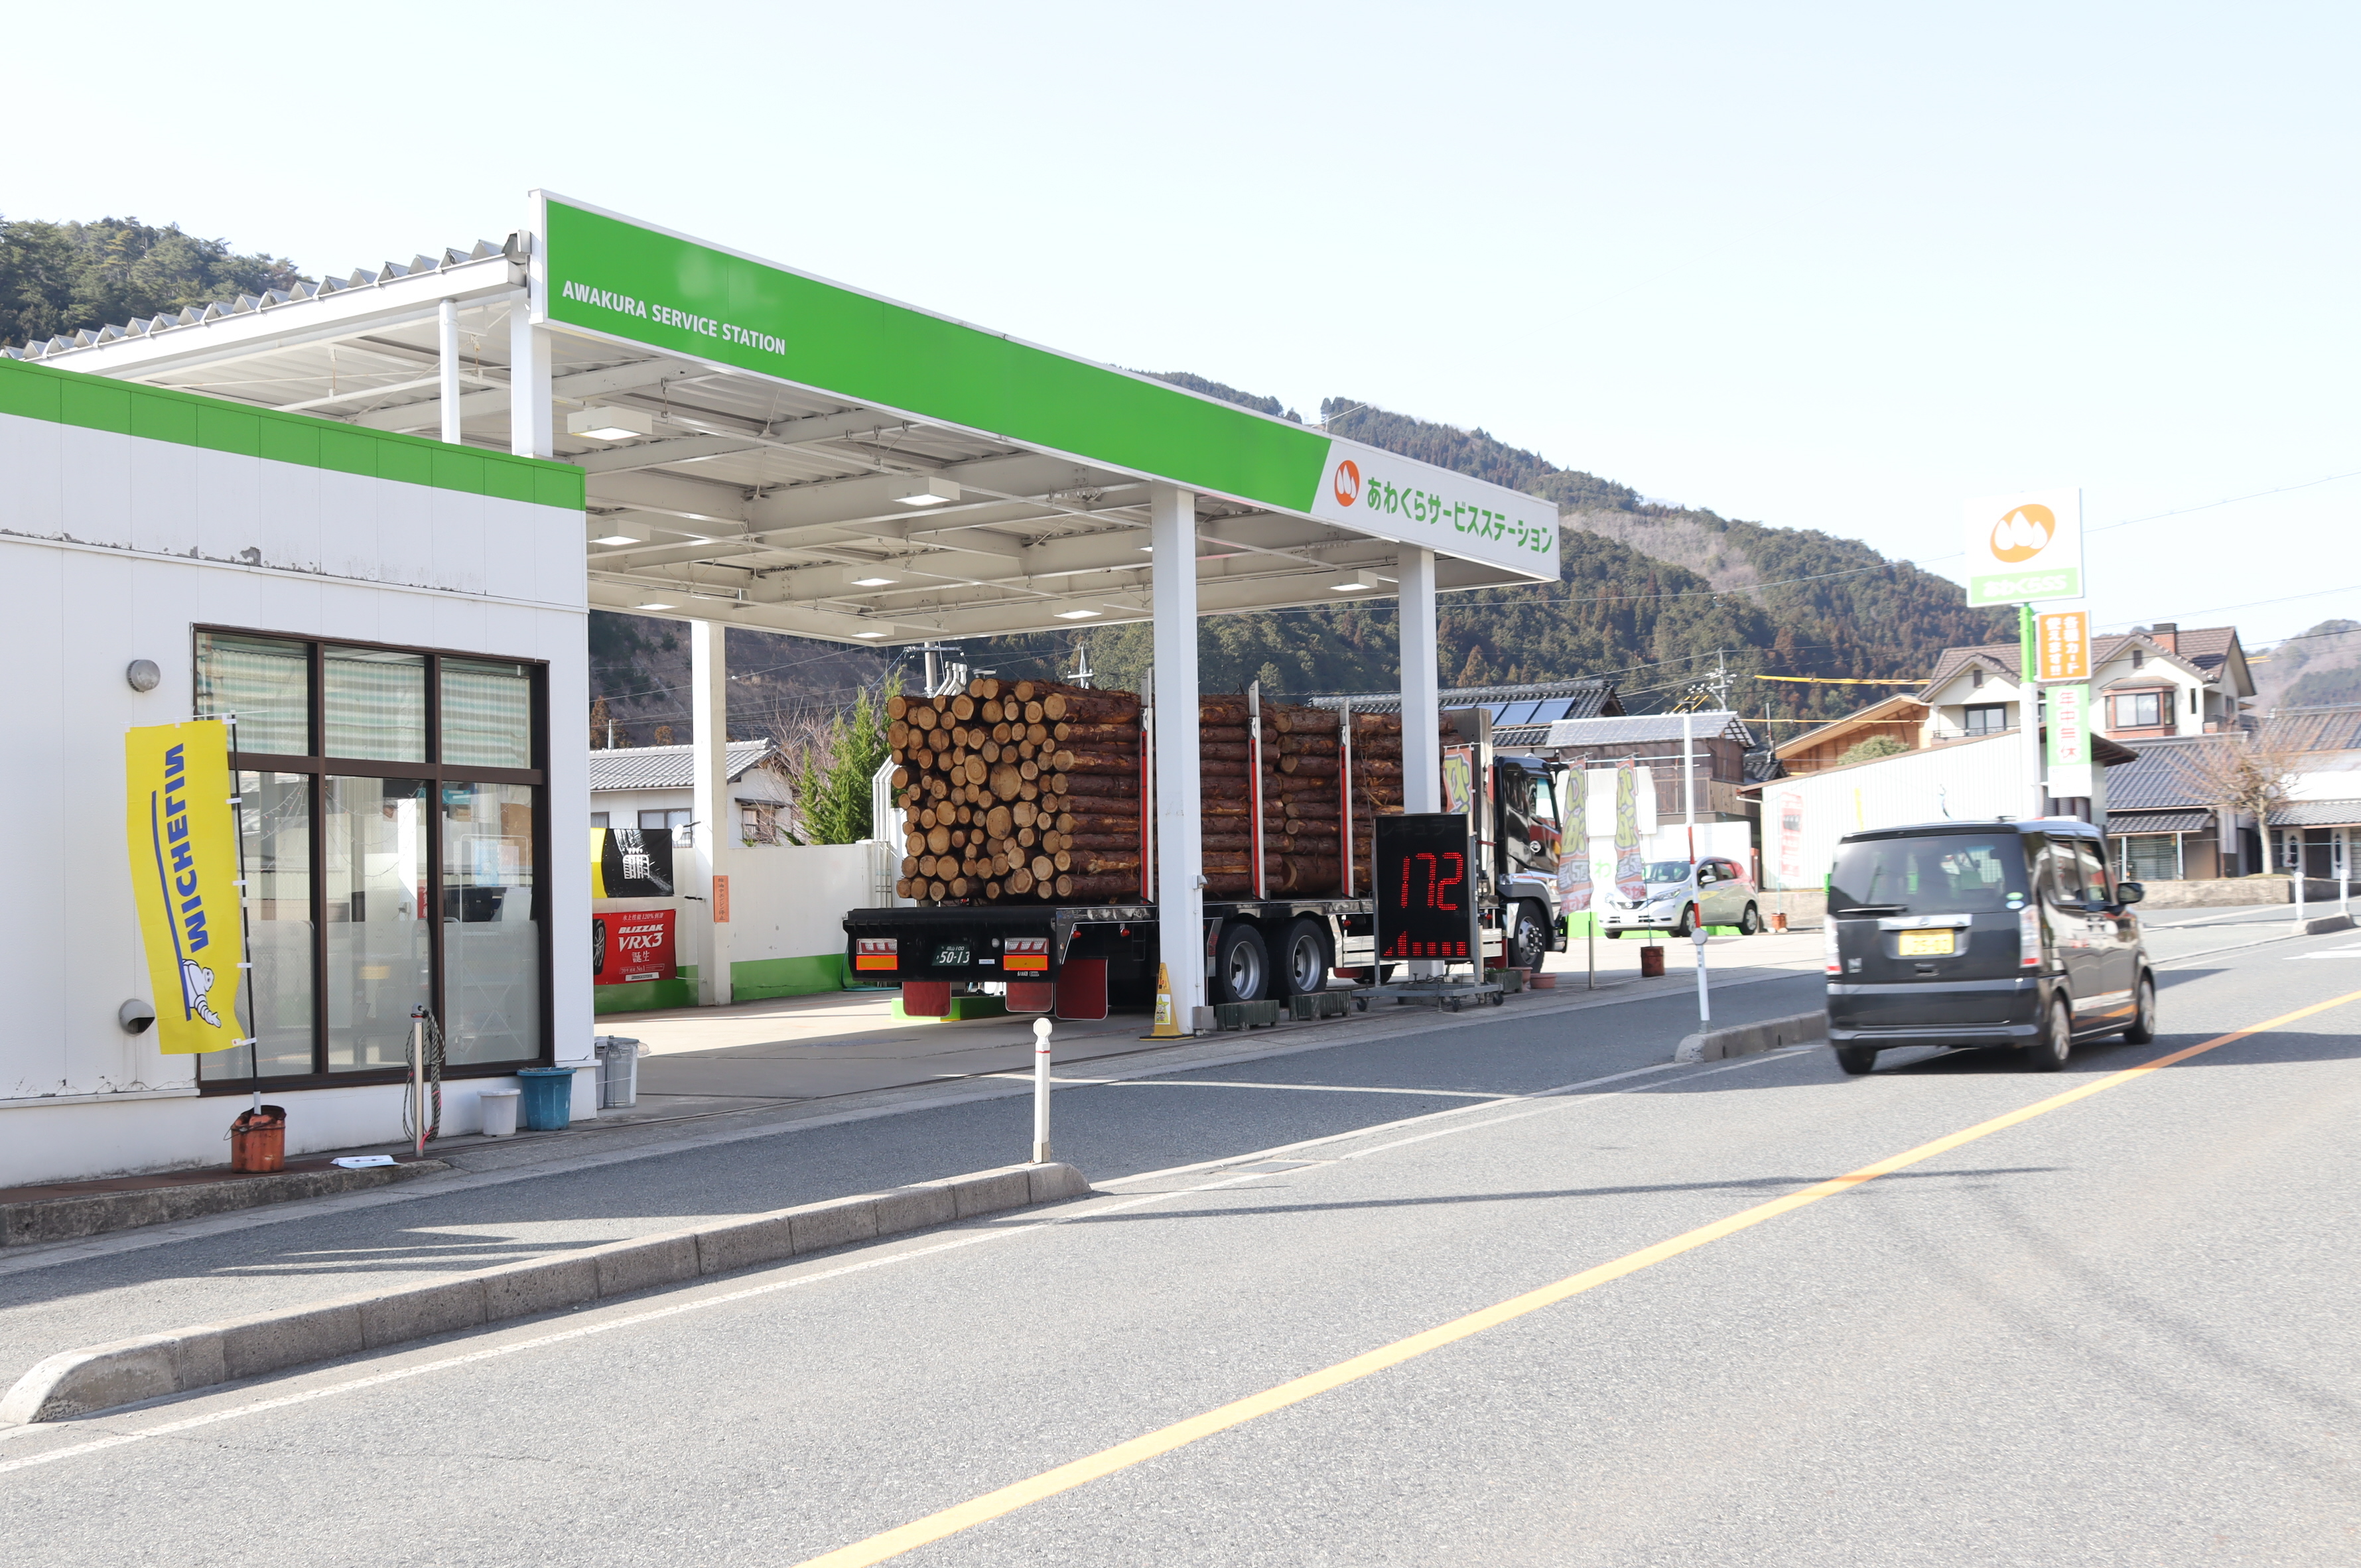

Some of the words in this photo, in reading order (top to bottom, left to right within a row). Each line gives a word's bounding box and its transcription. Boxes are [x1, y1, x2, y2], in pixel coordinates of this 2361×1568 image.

[563, 281, 647, 318] AWAKURA
[651, 304, 717, 338] SERVICE
[722, 324, 785, 356] STATION
[1367, 477, 1552, 553] あわくらサービスステーション
[2063, 616, 2080, 675] 各種カード
[1381, 818, 1464, 837] レギュラー
[165, 743, 209, 953] MICHELIN
[1400, 852, 1463, 910] 172
[618, 924, 664, 934] BLIZZAK
[618, 932, 664, 952] VRX3
[632, 950, 649, 962] 誕生
[939, 951, 970, 964] 50-13
